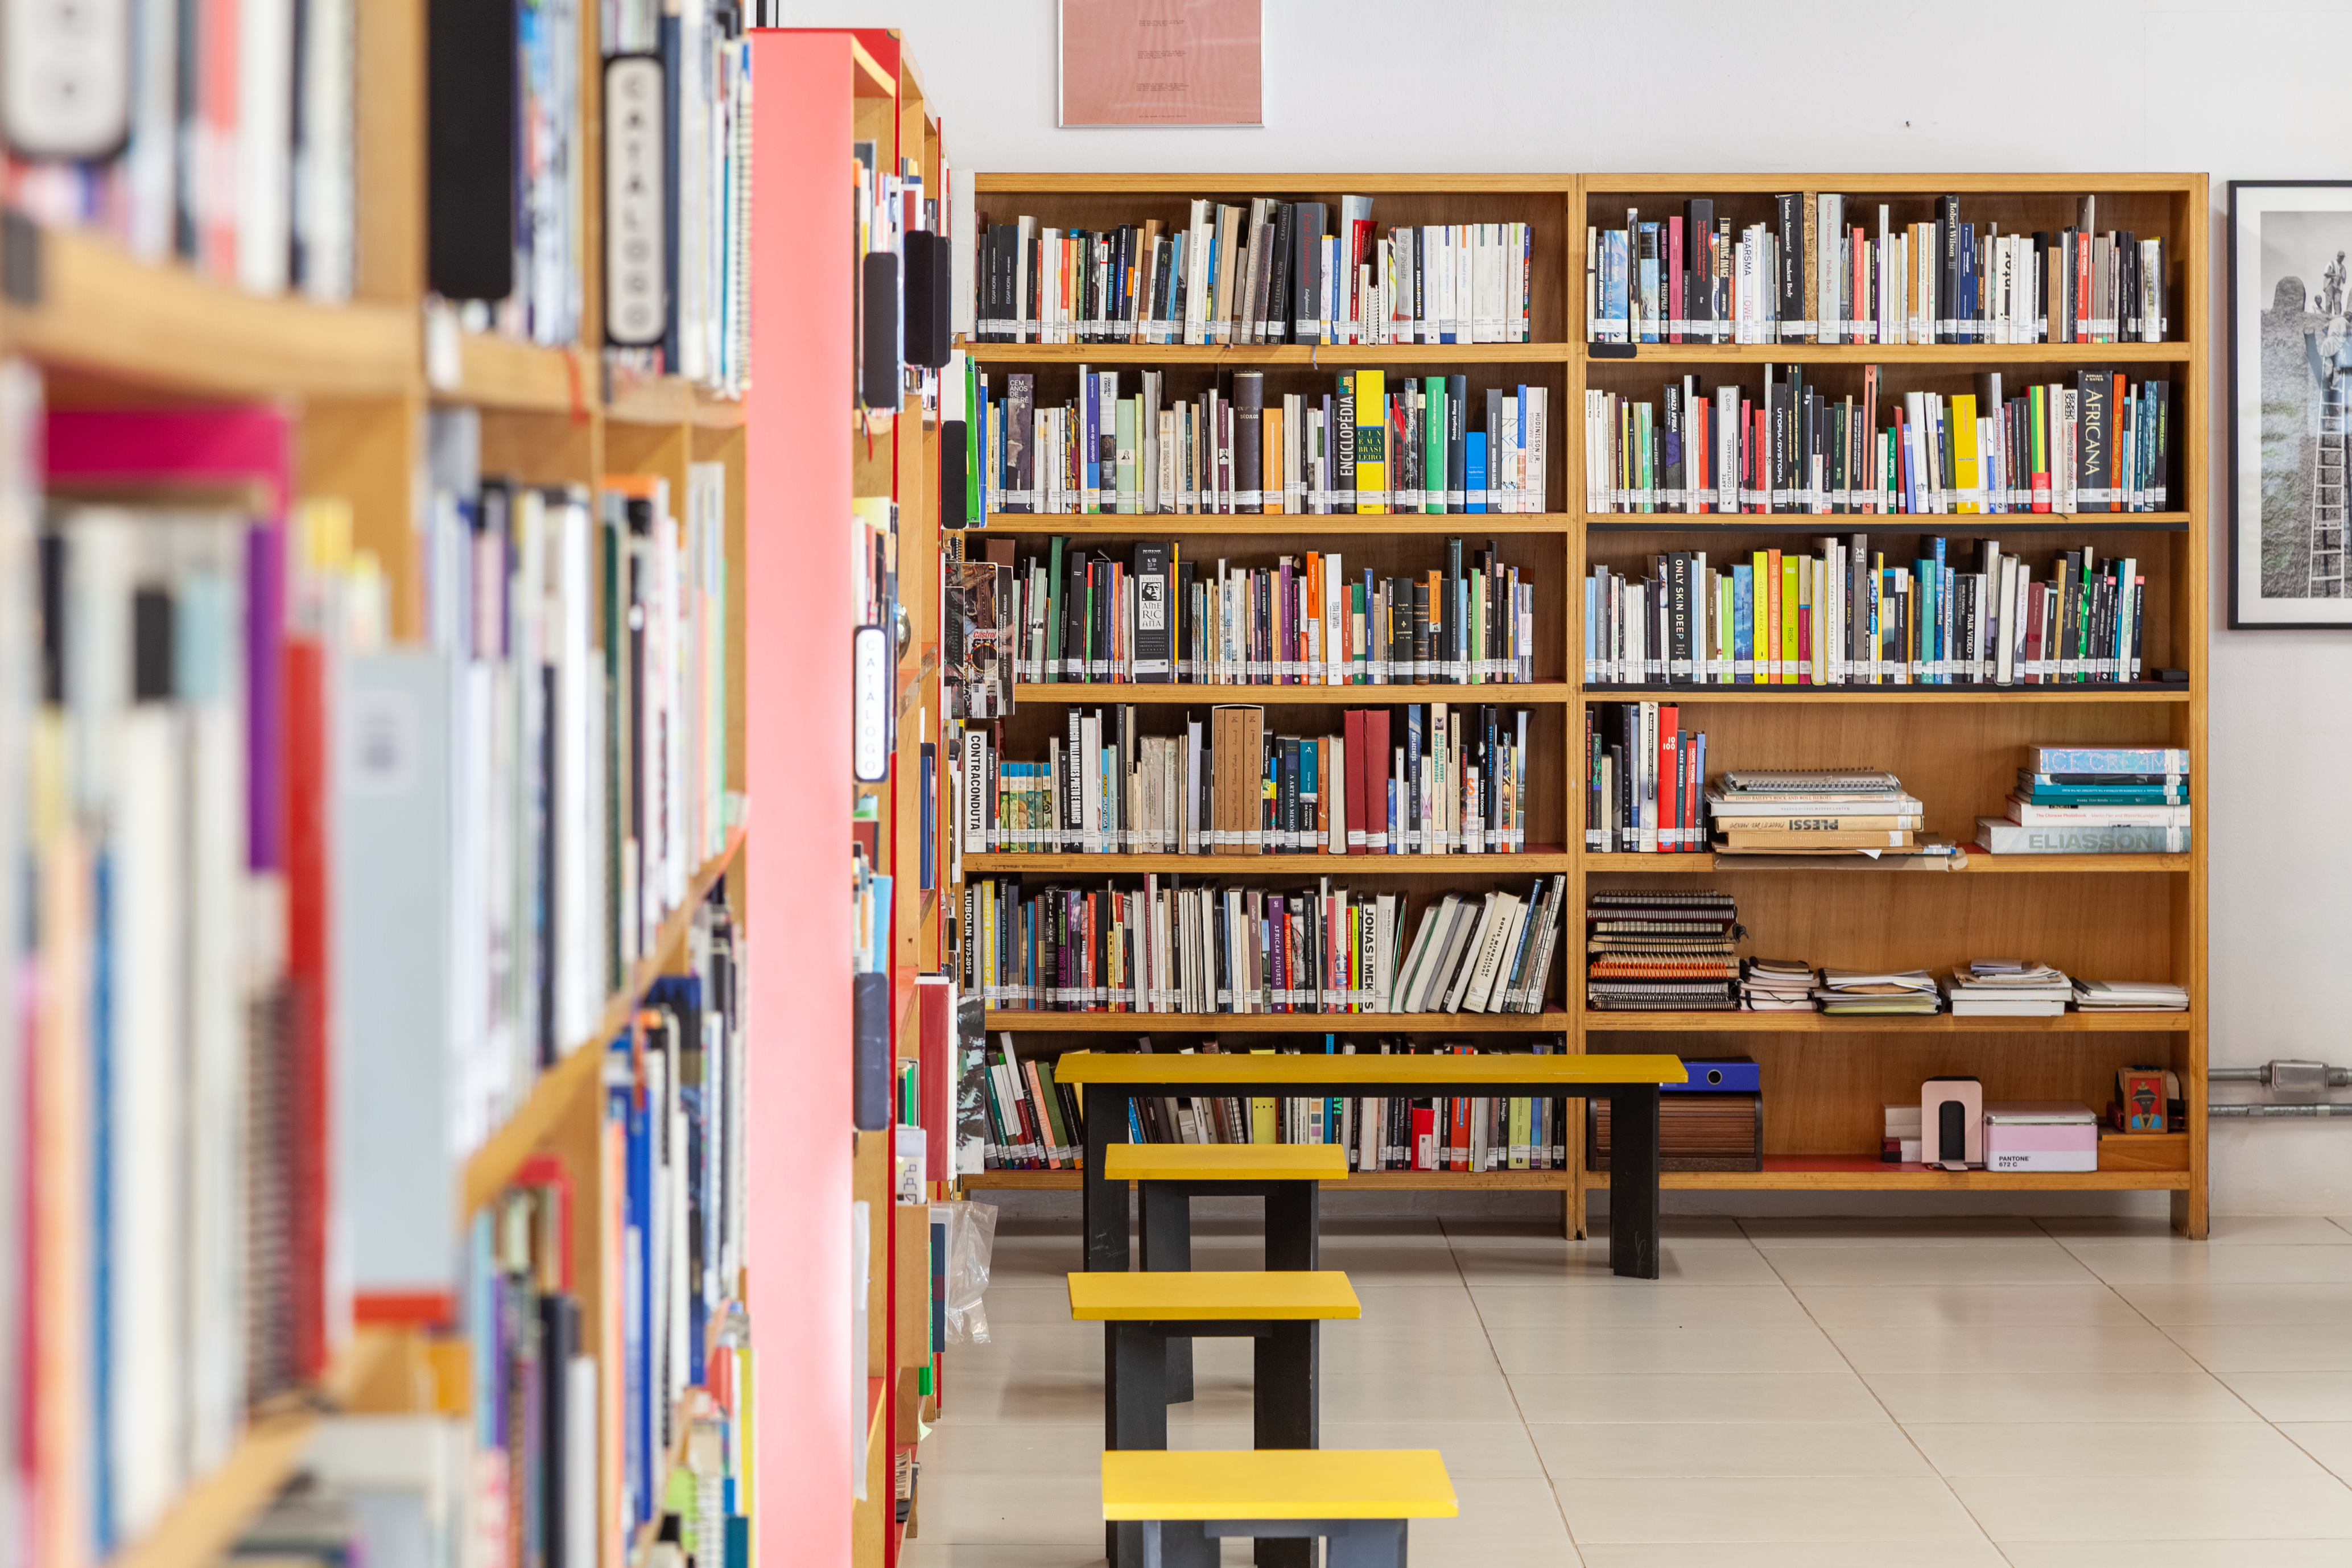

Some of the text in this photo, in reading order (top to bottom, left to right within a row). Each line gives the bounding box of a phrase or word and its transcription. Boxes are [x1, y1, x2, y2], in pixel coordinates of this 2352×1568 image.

[1244, 218, 1261, 321] SALVADOR CRAVONETO
[1303, 213, 1313, 286] Exu Iluminado
[1338, 396, 1354, 476] ENCICLOPÉDIA
[2085, 389, 2103, 476] AFRICANA
[1142, 610, 1161, 618] RIC
[866, 639, 876, 771] CATALOGO
[971, 736, 981, 830] CONTRACONDUTA
[2045, 752, 2167, 771] ICE CREAM
[1789, 819, 1838, 830] PLESSI
[2029, 833, 2153, 849] ELIASSON
[1480, 952, 1491, 976] HISTORY
[1484, 917, 1505, 977] BORIS MIKHAILOV
[1036, 1095, 1051, 1145] AFRICAN FASHION
